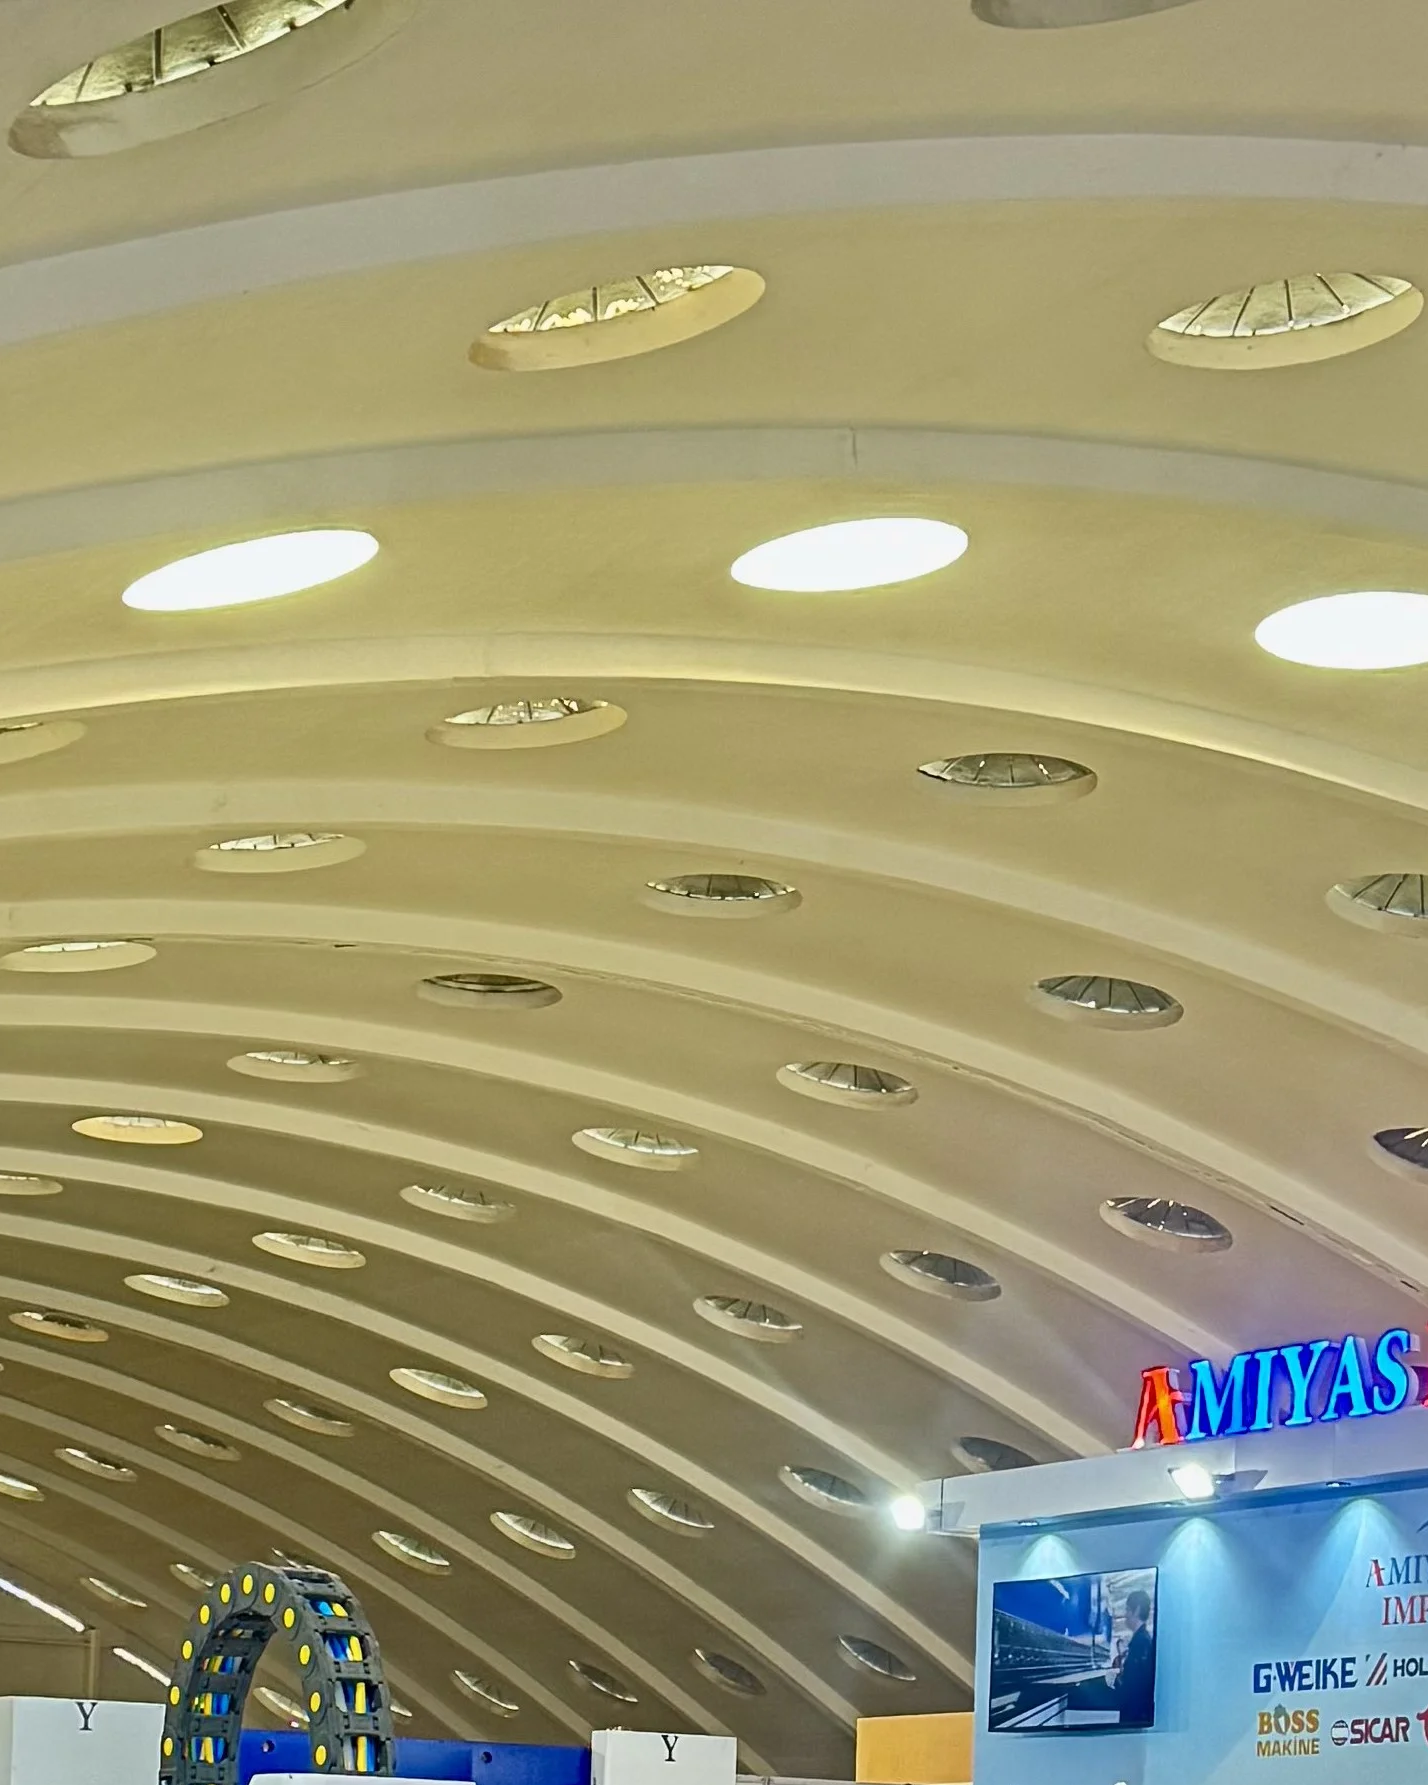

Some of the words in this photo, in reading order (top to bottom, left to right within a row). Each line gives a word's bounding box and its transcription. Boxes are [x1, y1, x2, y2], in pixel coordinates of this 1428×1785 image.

[1131, 1328, 1414, 1450] AMIYAS
[75, 1701, 98, 1731] Y
[1257, 1706, 1320, 1736] BOSS
[1349, 1716, 1410, 1745] SICAR
[661, 1734, 679, 1762] Y
